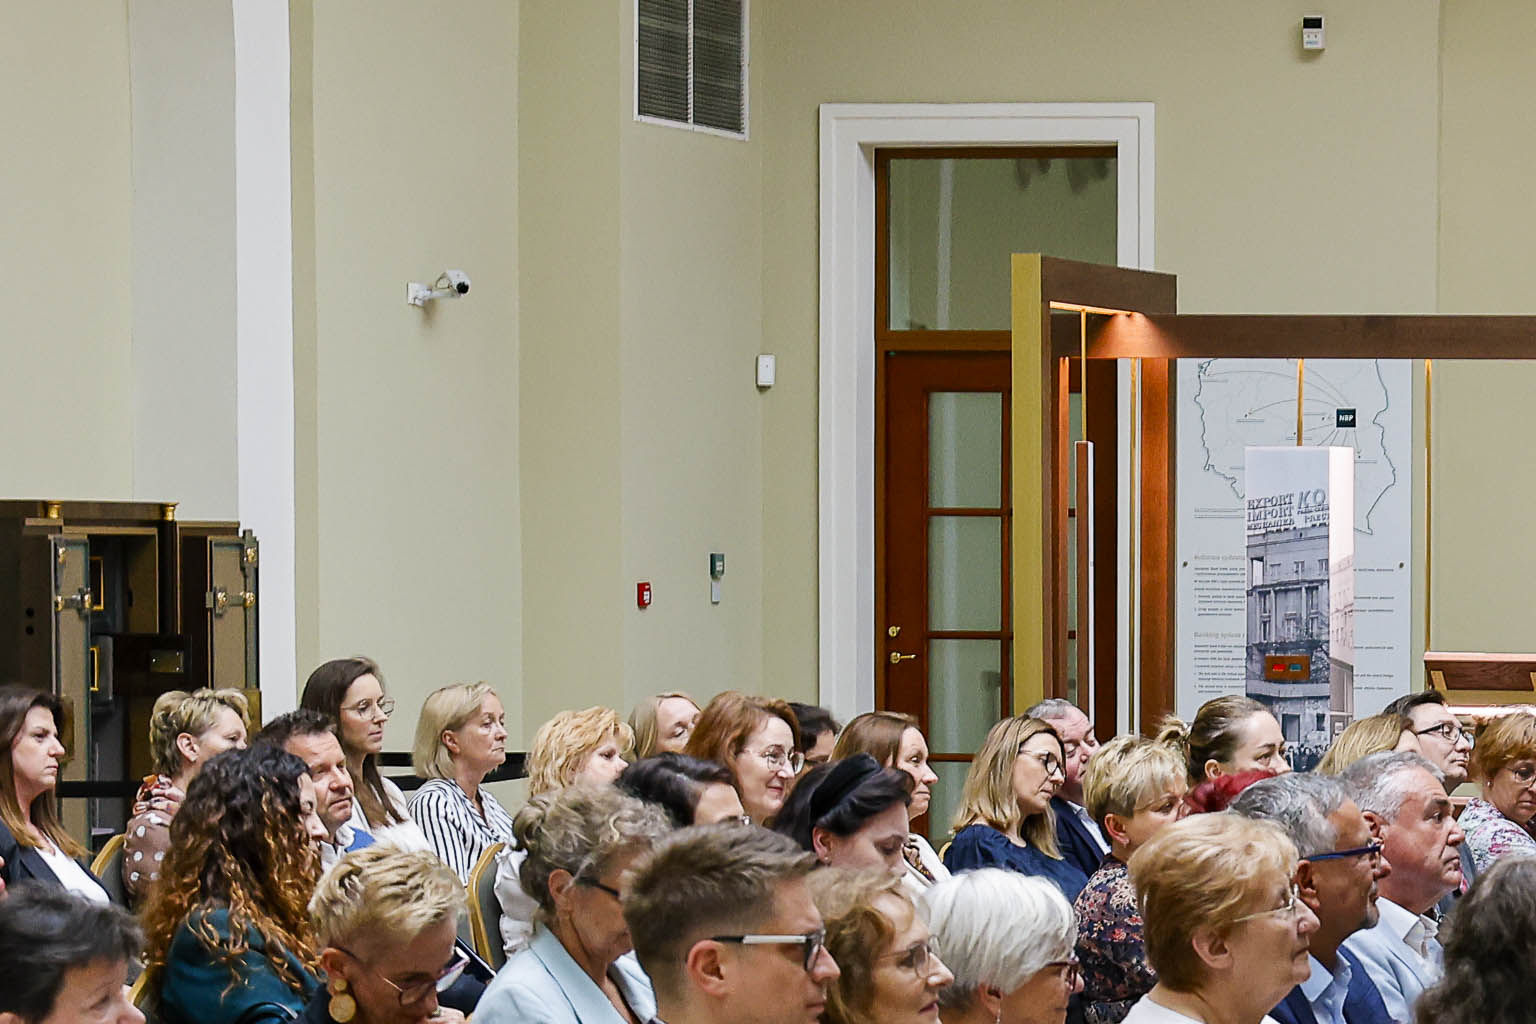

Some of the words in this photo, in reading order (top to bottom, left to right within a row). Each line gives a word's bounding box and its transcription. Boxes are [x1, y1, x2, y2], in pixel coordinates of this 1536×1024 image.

[1339, 414, 1354, 422] NBP
[1247, 493, 1294, 508] EXPORT
[1247, 506, 1294, 522] IMPORT
